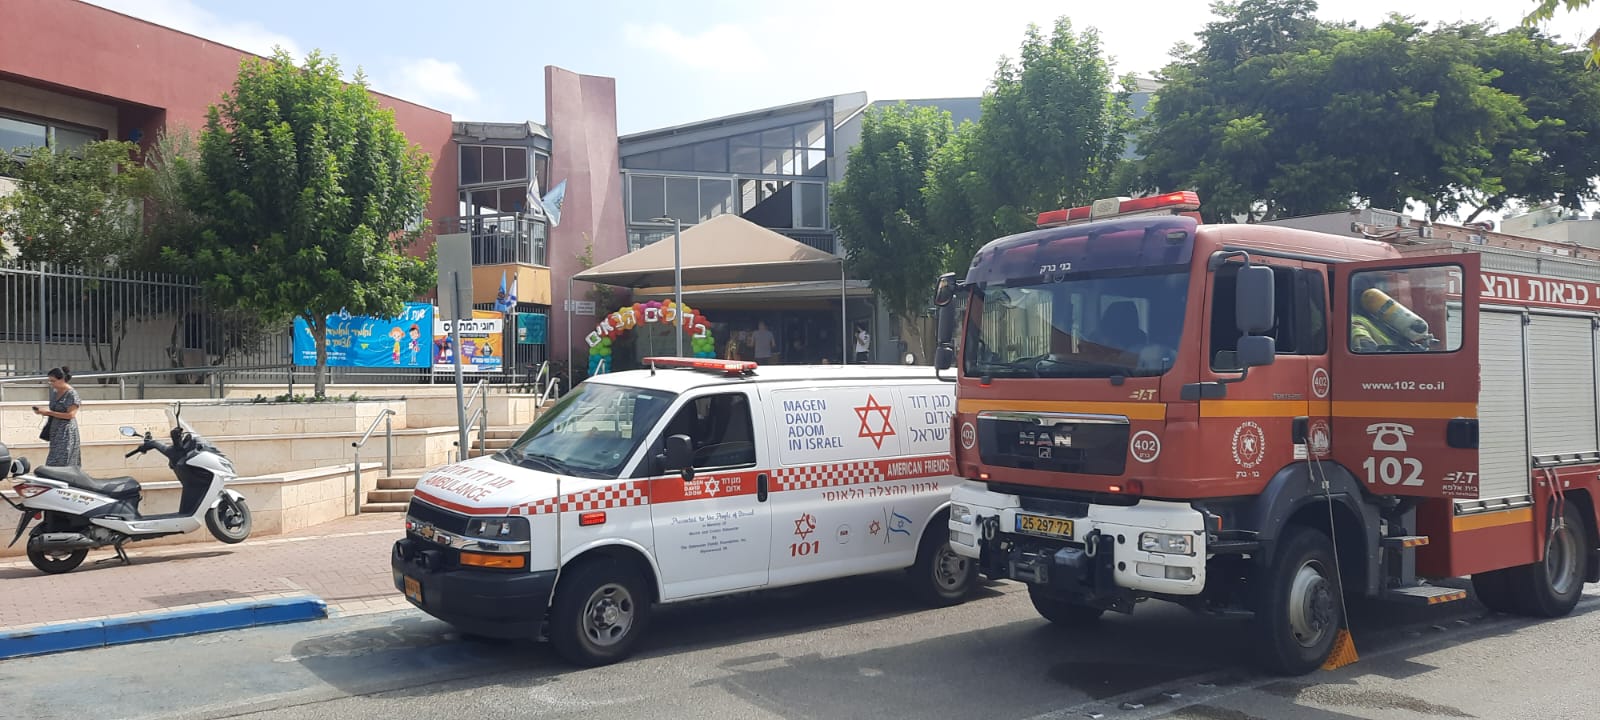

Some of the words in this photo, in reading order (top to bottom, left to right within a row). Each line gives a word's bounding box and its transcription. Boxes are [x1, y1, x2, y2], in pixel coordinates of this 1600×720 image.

[1039, 264, 1056, 274] ברק
[1059, 262, 1071, 271] בני
[1527, 279, 1589, 305] כבאות
[443, 321, 479, 332] המתס
[480, 322, 495, 331] חוגי
[1314, 376, 1327, 386] 402
[783, 400, 826, 412] MAGEN
[908, 395, 927, 408] דוד
[932, 395, 950, 410] מגן
[785, 412, 822, 425] DAVID
[925, 411, 952, 424] אדום
[788, 425, 824, 438] ADOM
[909, 427, 950, 442] ישראל
[789, 439, 802, 451] IN
[805, 437, 843, 450] ISRAEL
[1019, 431, 1072, 447] MAN
[1134, 440, 1156, 451] 402
[888, 461, 922, 476] AMERICAN
[924, 458, 950, 474] FRIENDS
[1363, 456, 1424, 487] 102
[424, 474, 491, 502] AMBULANCE
[869, 484, 907, 497] ההצלה
[911, 482, 939, 495] ארגון
[822, 488, 864, 502] הלאומי
[789, 540, 820, 557] 101
